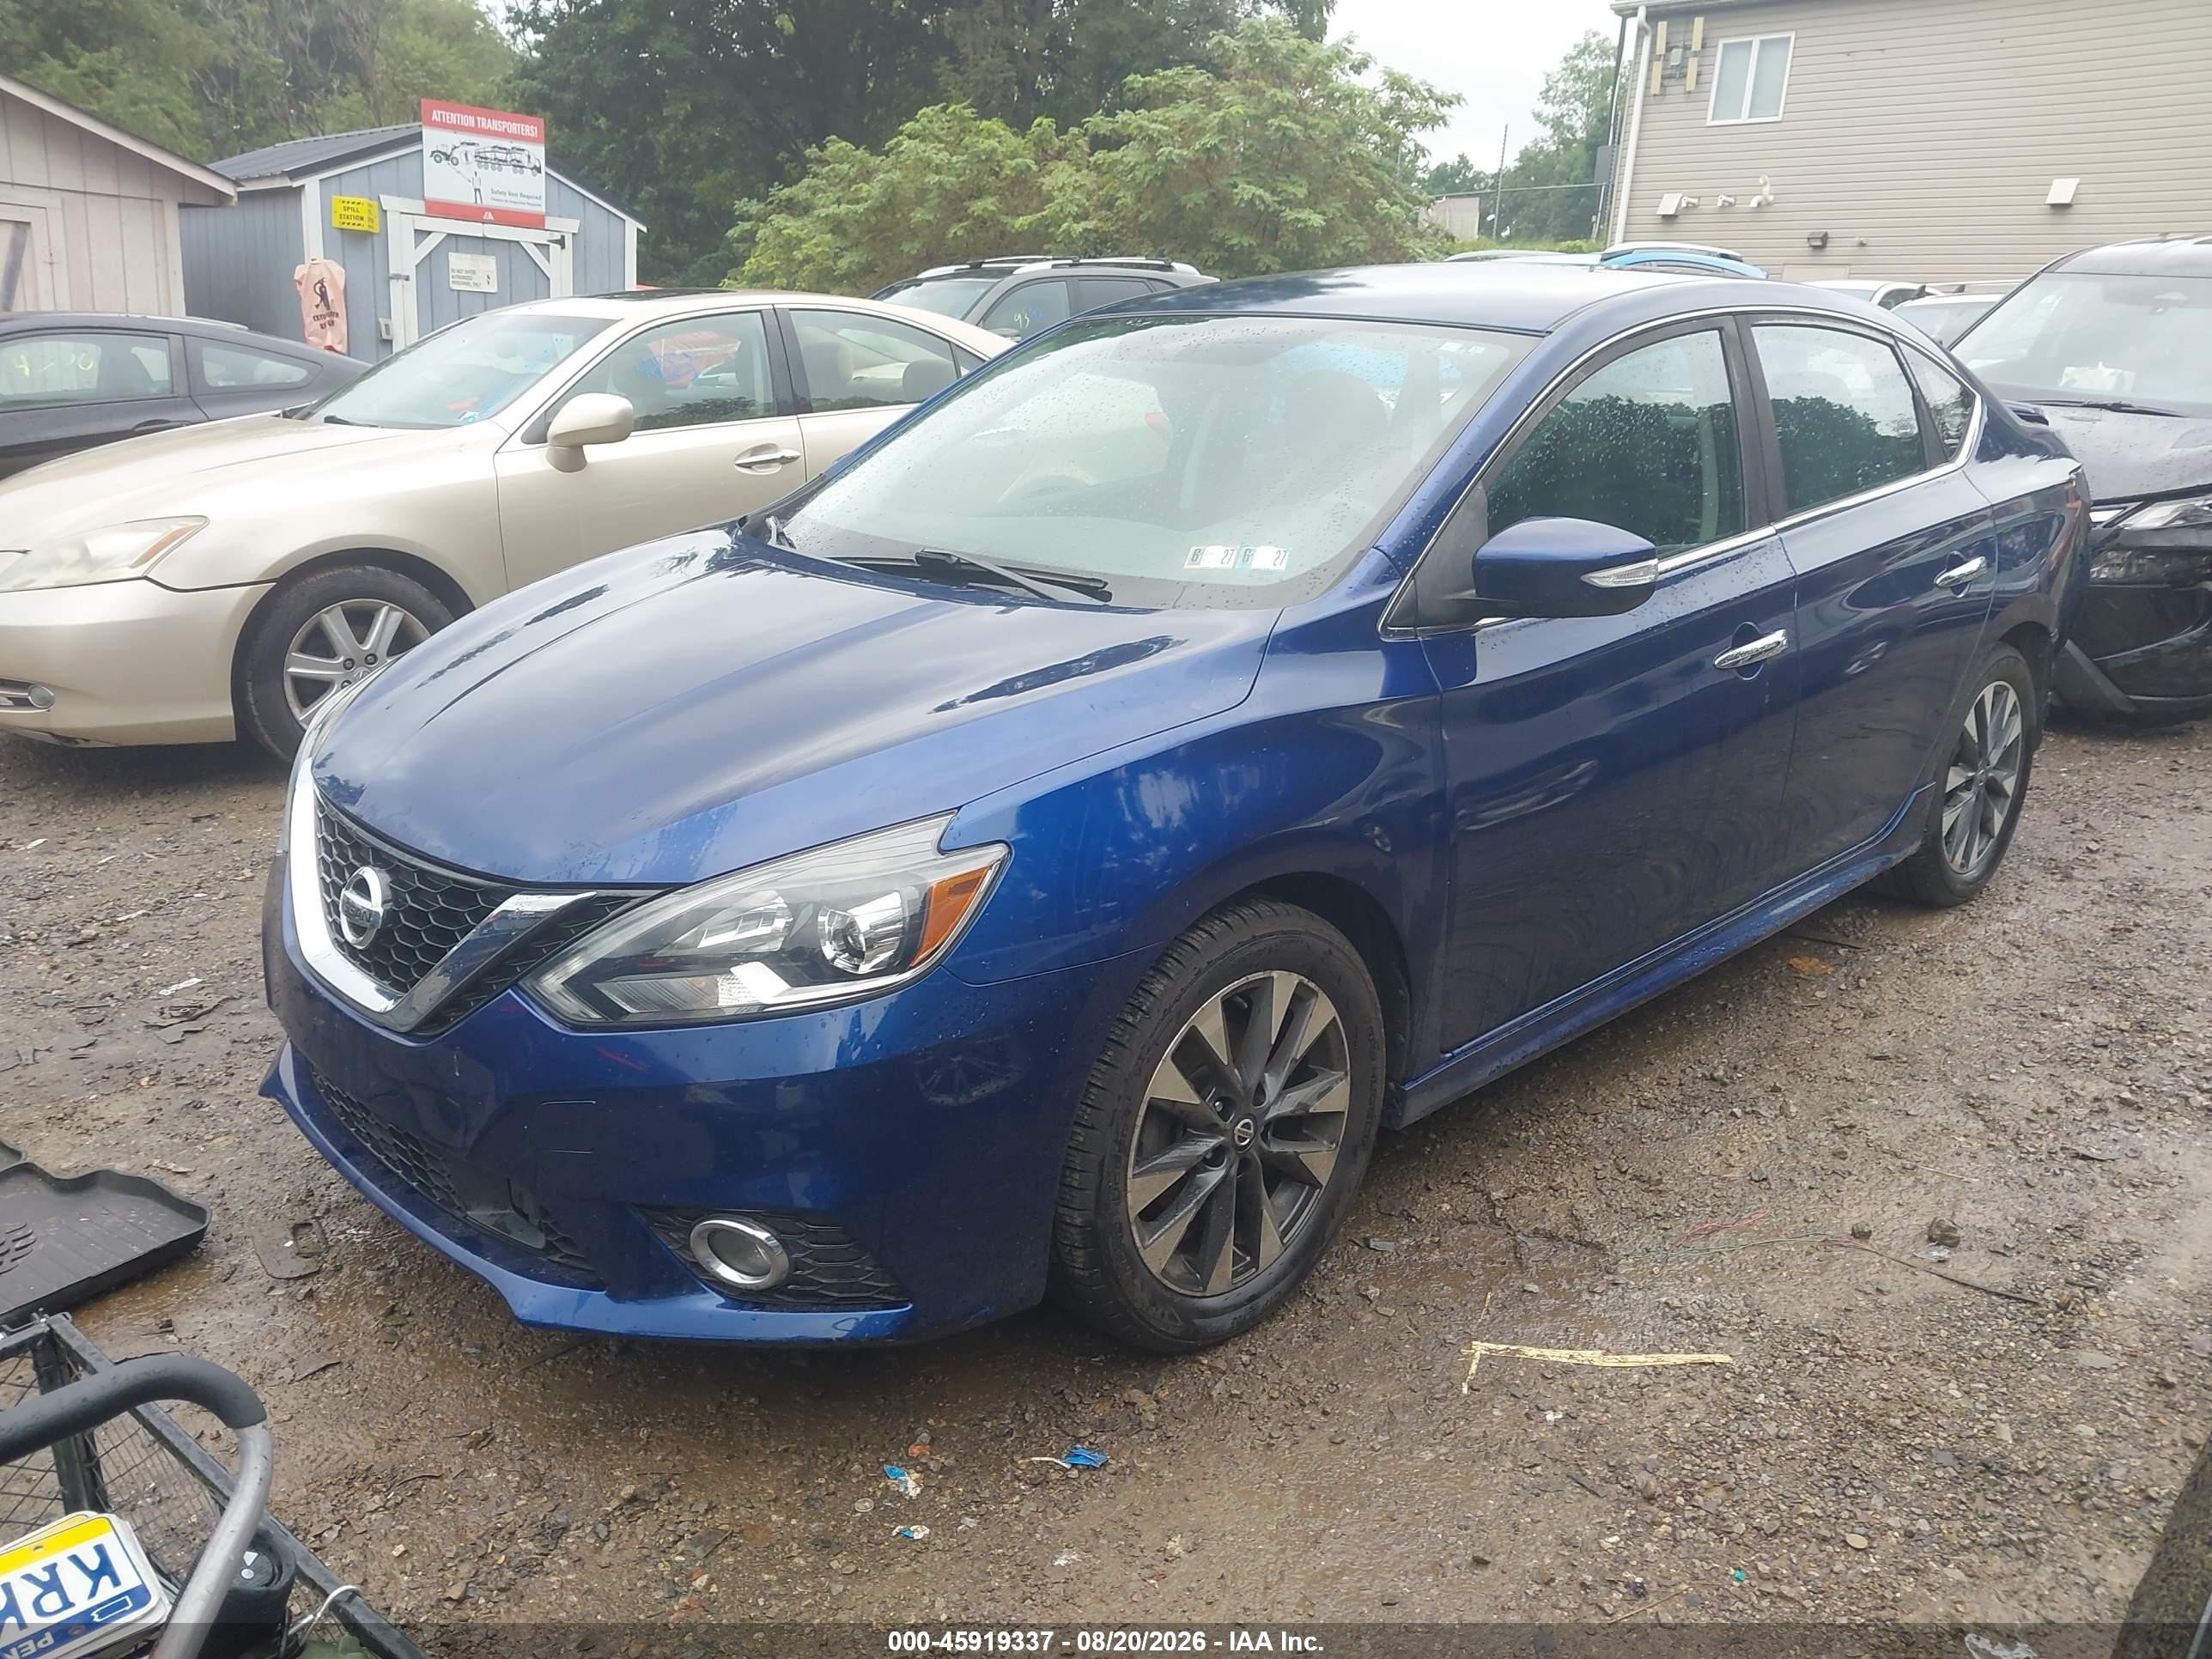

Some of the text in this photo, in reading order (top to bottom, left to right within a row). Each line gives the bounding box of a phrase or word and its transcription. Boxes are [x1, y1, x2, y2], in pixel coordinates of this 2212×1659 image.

[431, 109, 538, 138] ATTENTION TRANSPORTERS!
[490, 187, 507, 197] Safety
[519, 191, 542, 201] Required
[339, 213, 365, 222] STATION
[1219, 549, 1236, 565] 27
[1273, 550, 1287, 567] 27
